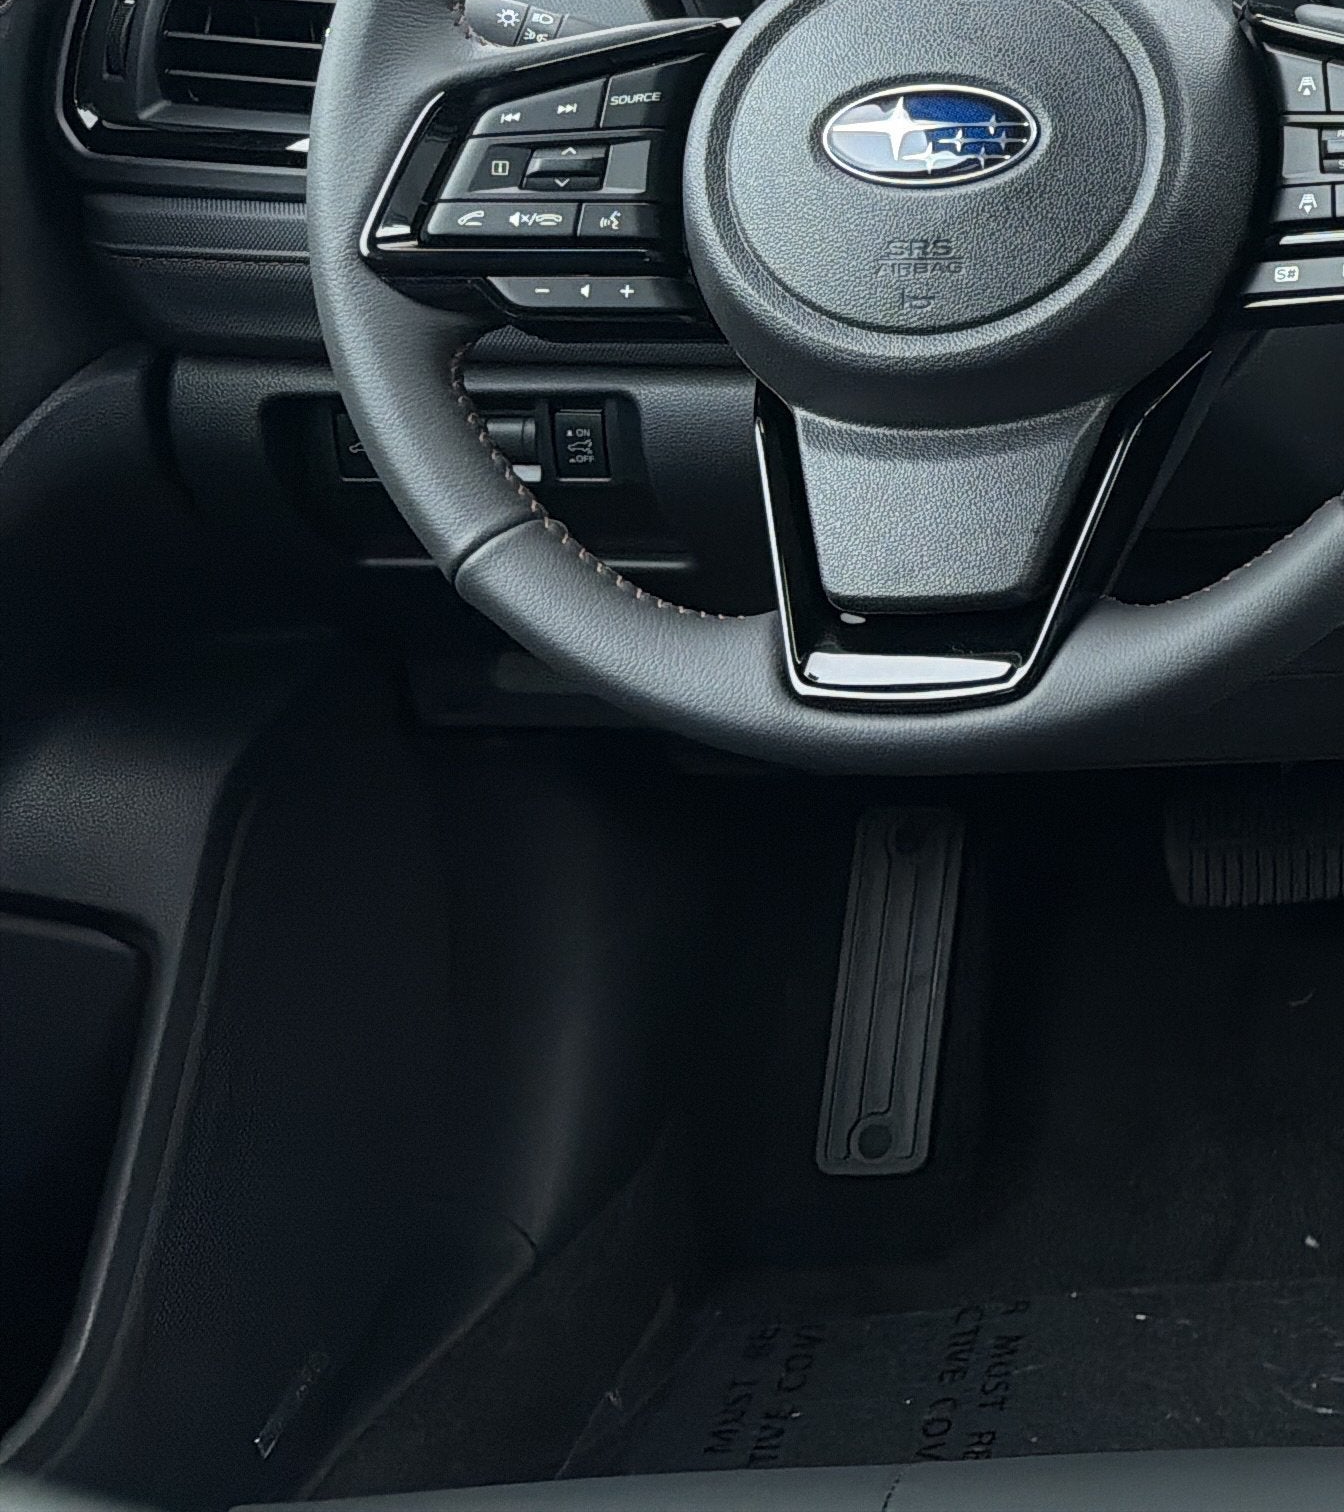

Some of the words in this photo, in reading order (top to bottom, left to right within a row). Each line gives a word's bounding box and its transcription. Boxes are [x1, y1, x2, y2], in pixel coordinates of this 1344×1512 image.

[610, 91, 662, 106] SOURCE
[887, 240, 953, 256] SRS
[876, 262, 965, 277] AIRBAG
[576, 428, 591, 437] ON
[575, 454, 595, 464] OFF
[978, 1335, 1024, 1411] MUST
